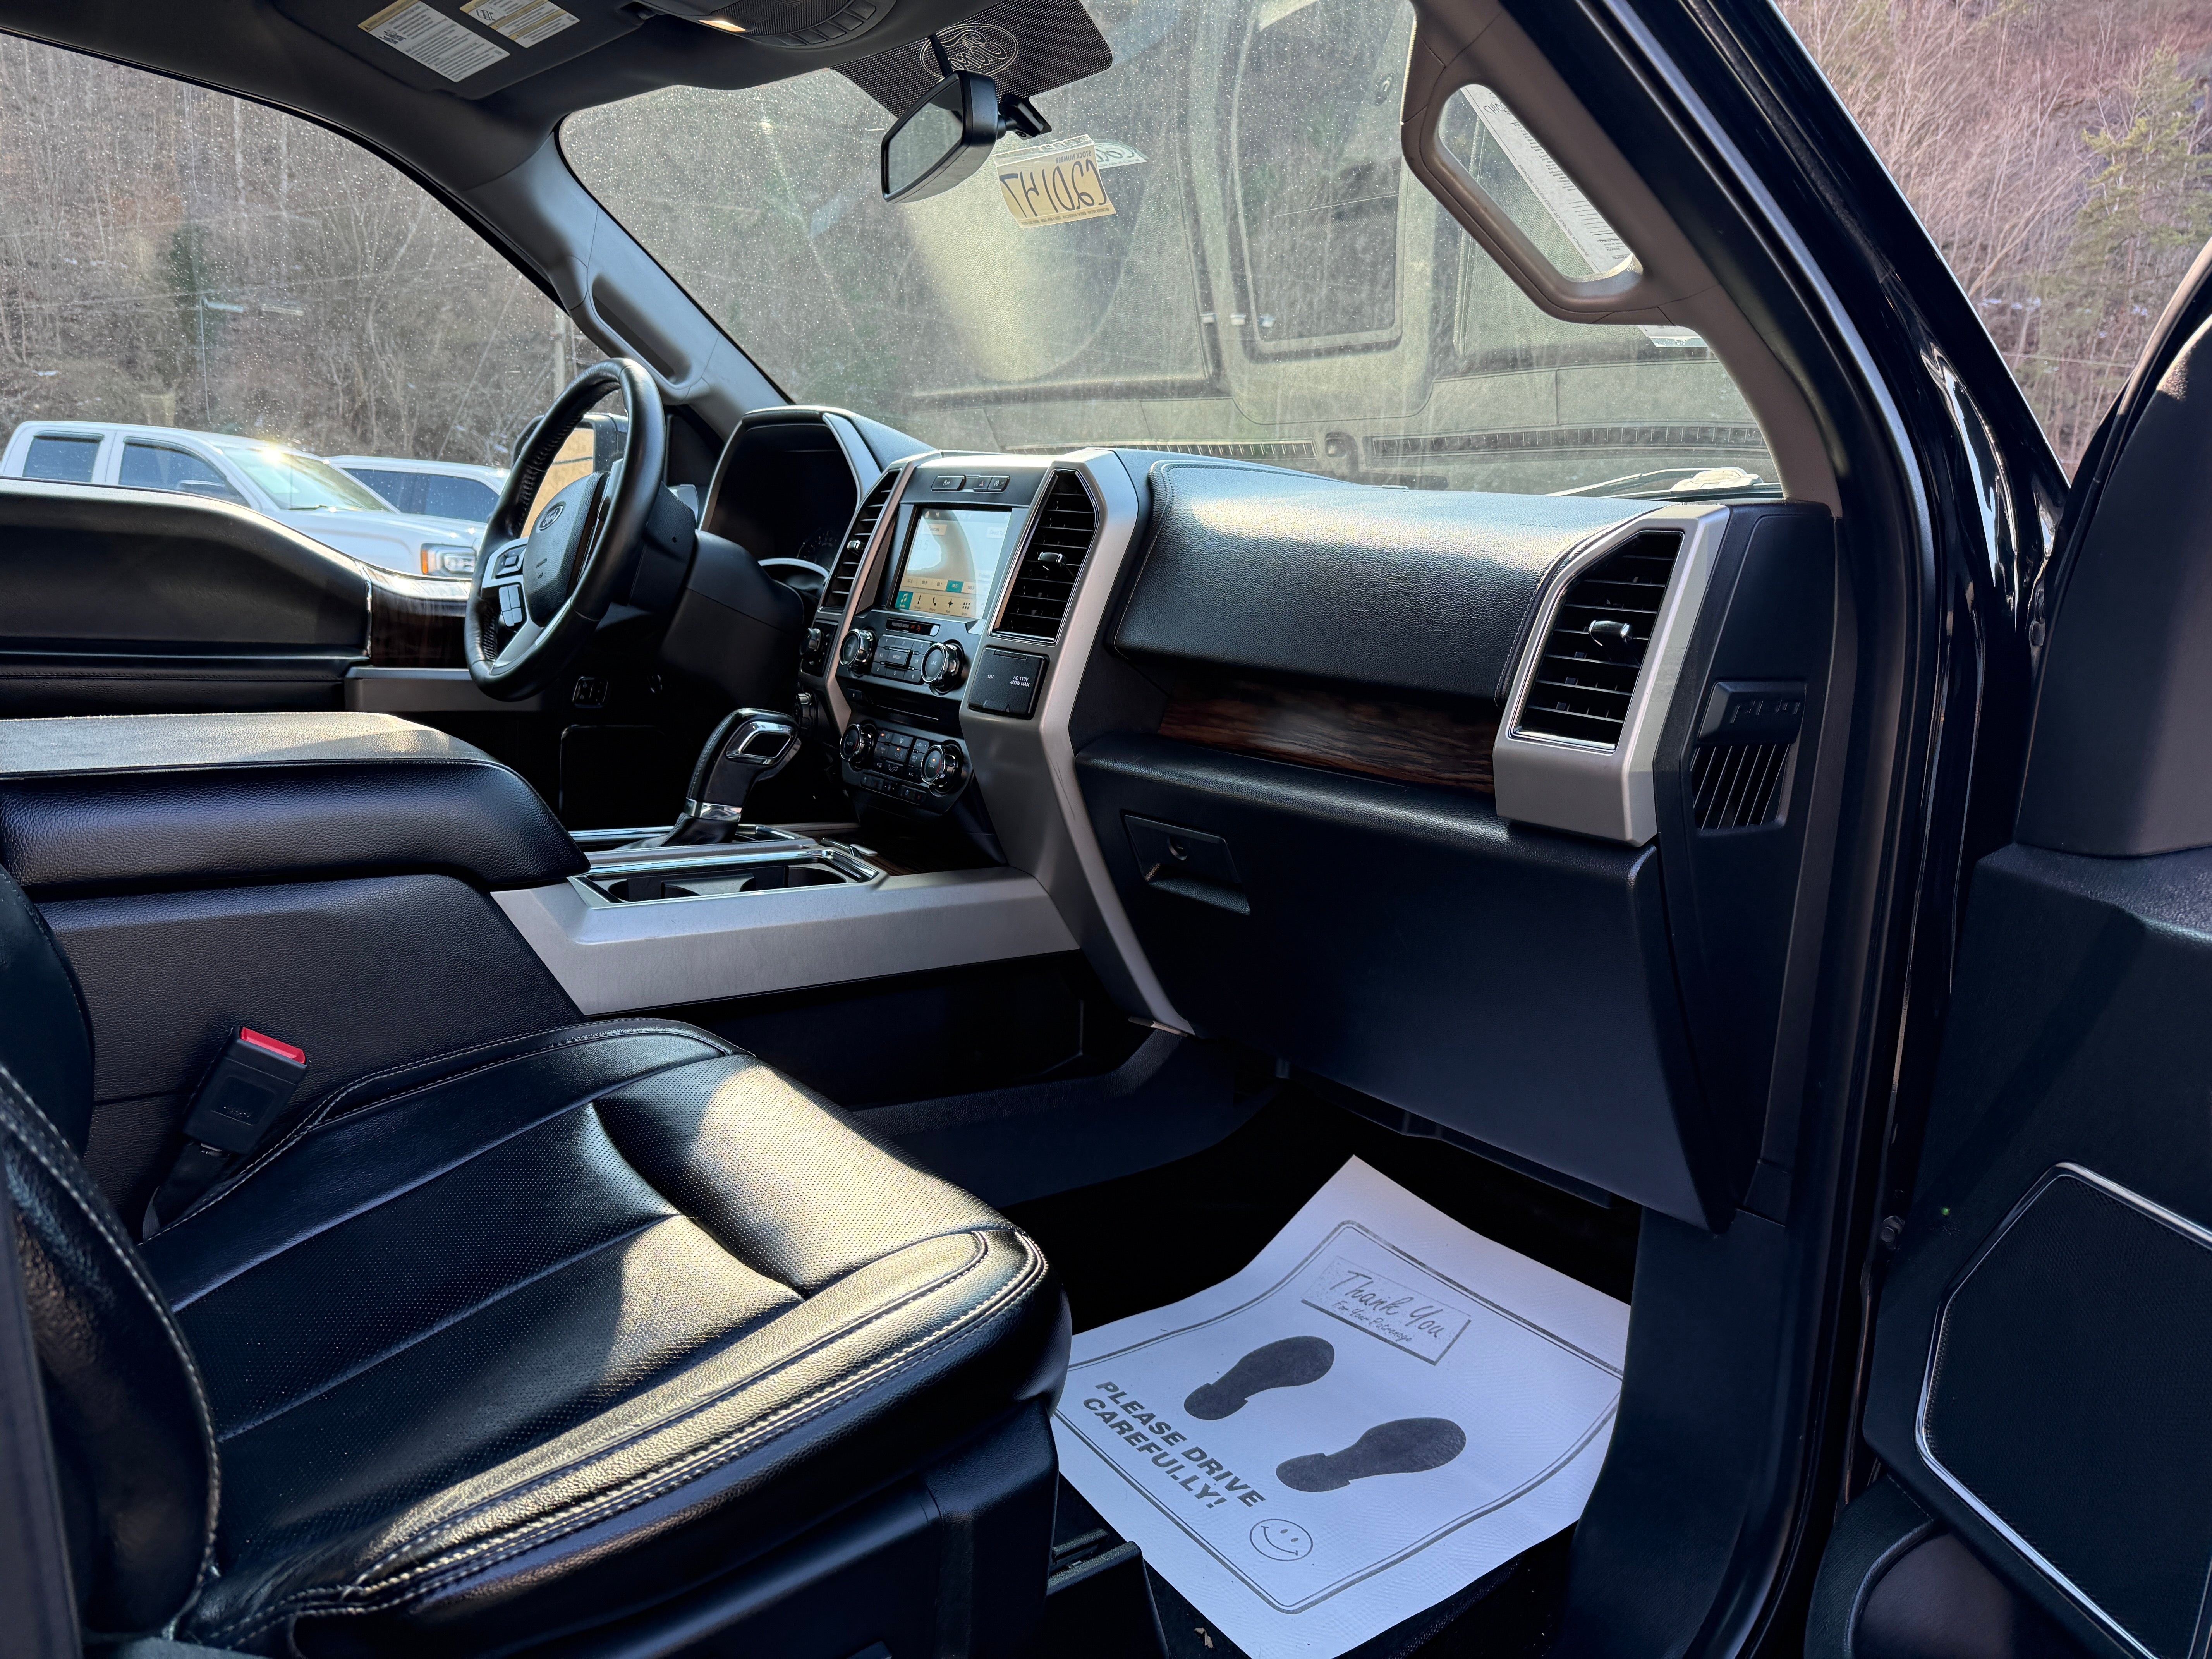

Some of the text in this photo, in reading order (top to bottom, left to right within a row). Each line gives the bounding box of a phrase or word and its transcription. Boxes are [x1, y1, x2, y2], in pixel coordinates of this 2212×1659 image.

[1330, 1270, 1445, 1338] Thank You
[1332, 1300, 1413, 1342] For Your Patronage
[1082, 1398, 1227, 1509] CAREFULLY!
[1096, 1381, 1267, 1508] PLEASE DRIVE
